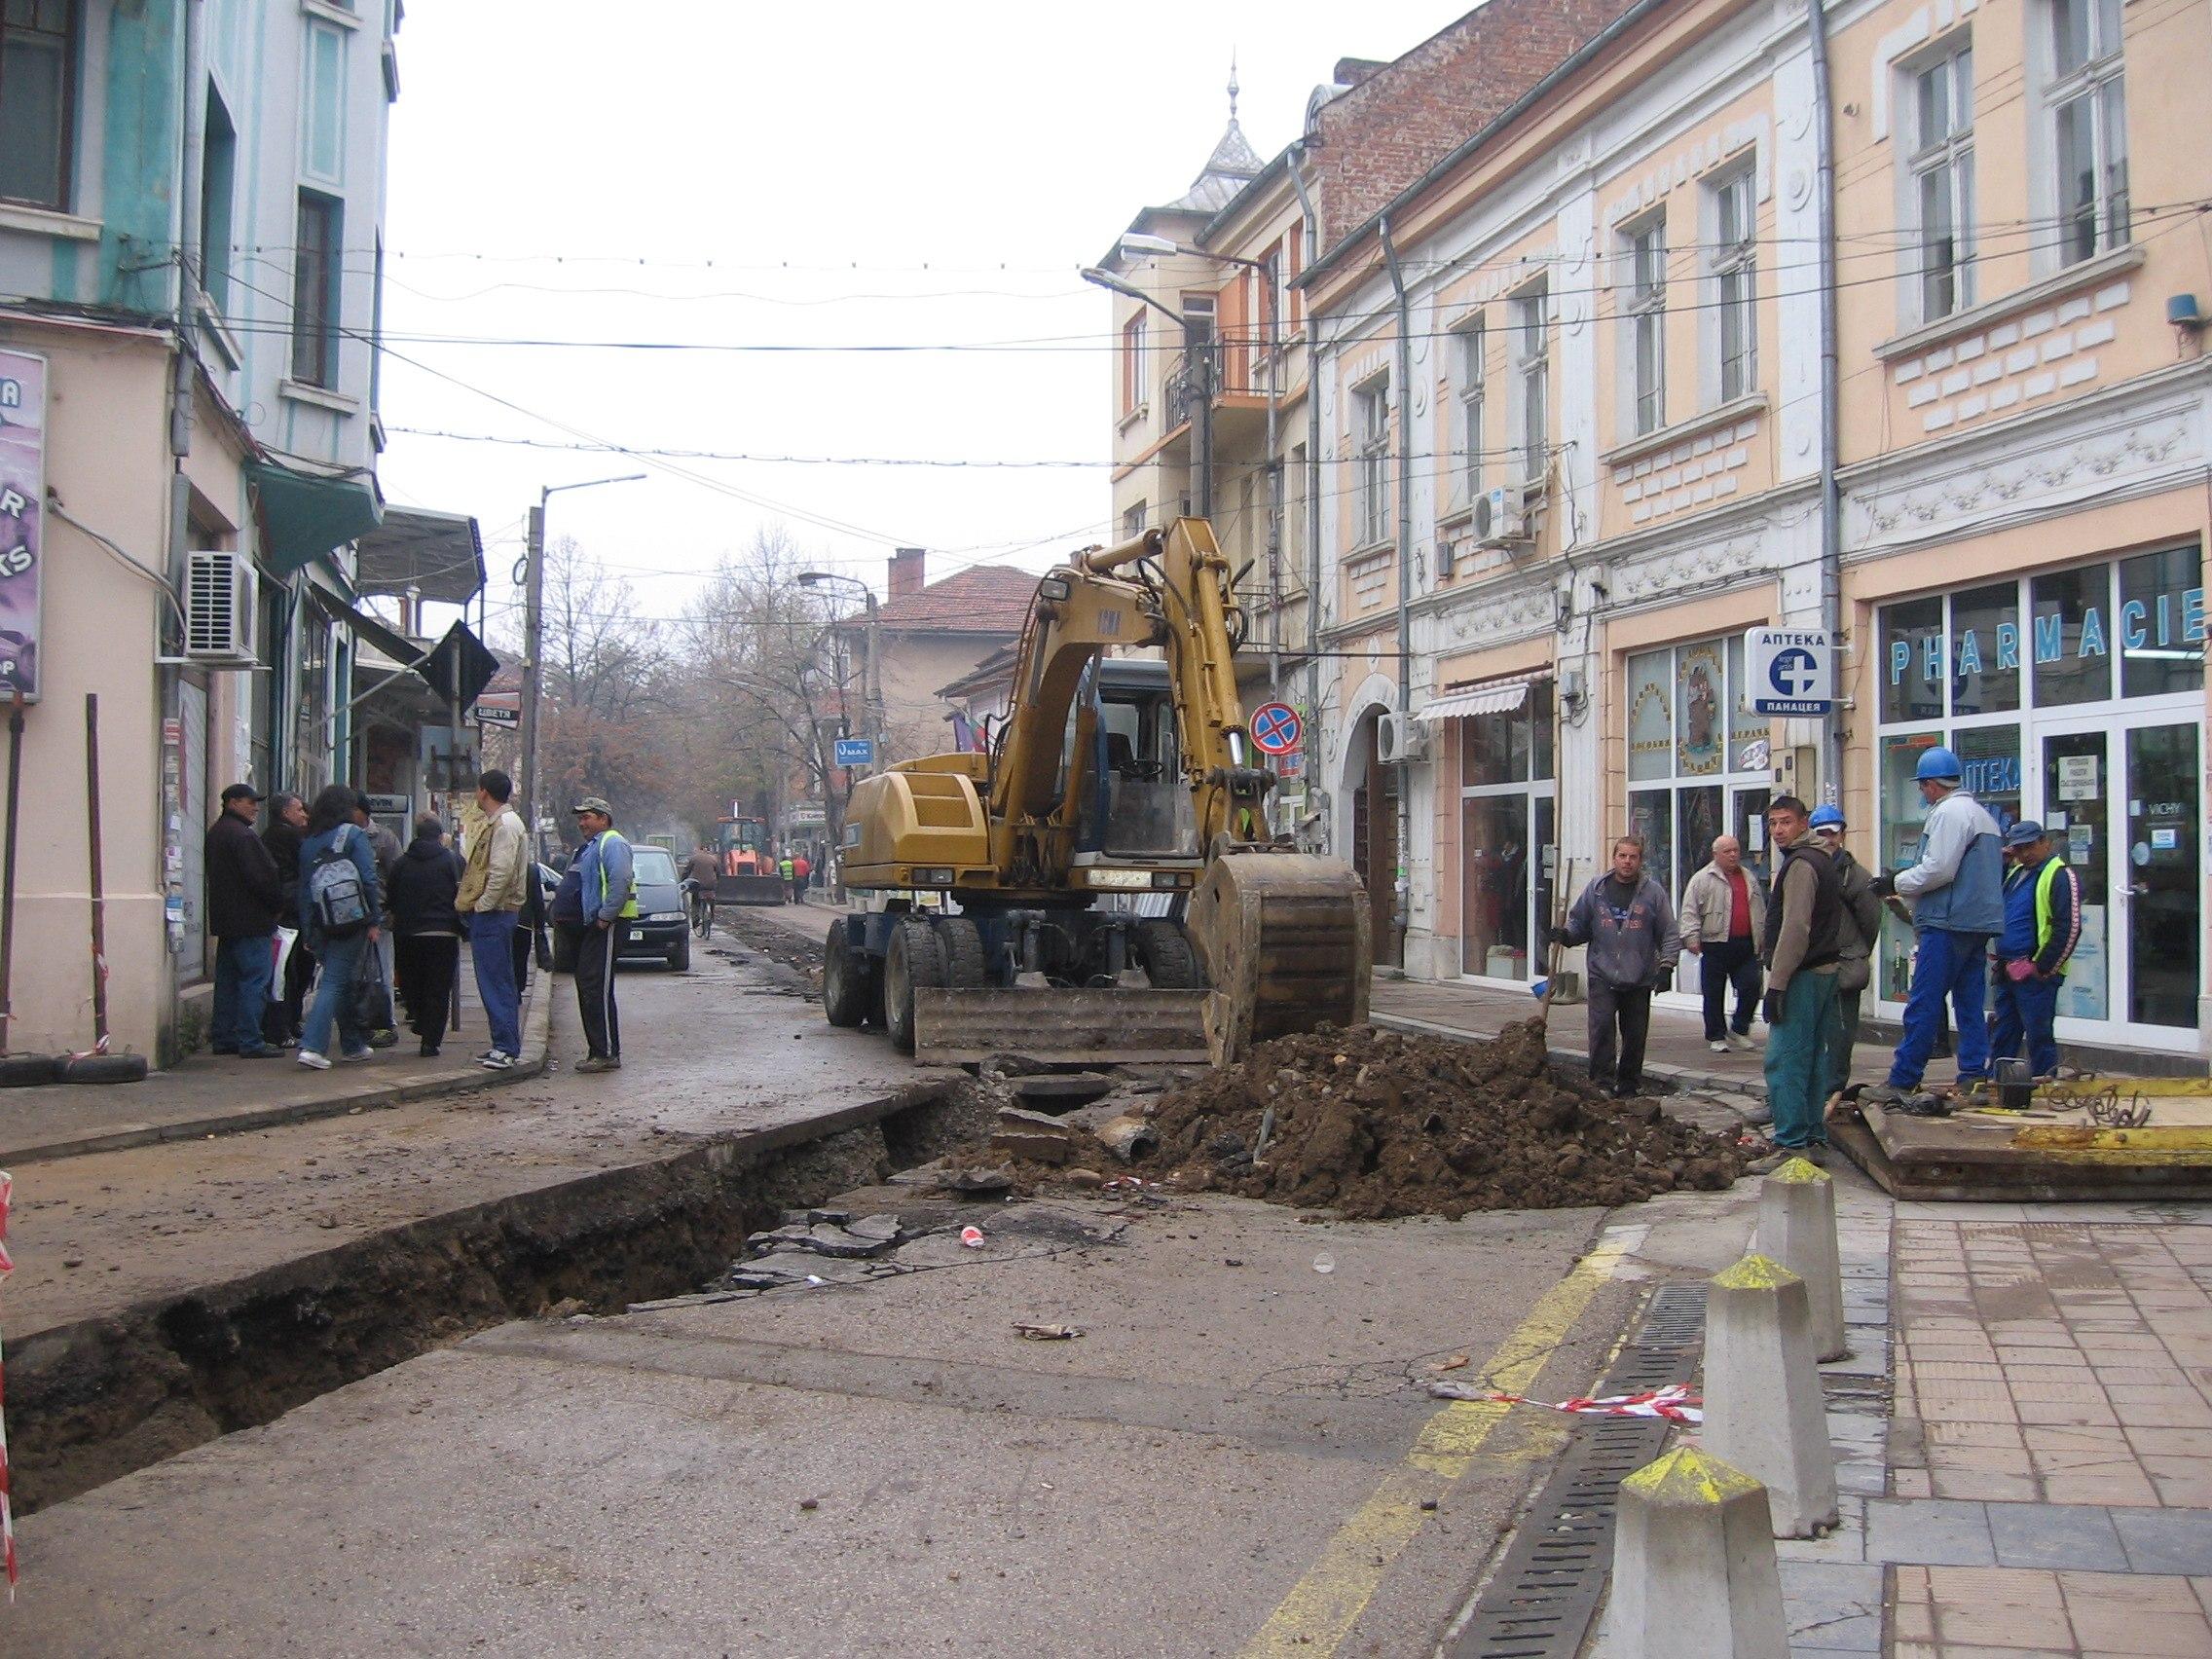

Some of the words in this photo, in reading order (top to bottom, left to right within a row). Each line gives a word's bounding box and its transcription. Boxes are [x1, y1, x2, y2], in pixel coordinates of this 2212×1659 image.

[1762, 634, 1825, 646] АПТЕКА
[1890, 587, 2204, 685] PHARMACIE
[1767, 702, 1821, 713] ПАНАЦЕЯ
